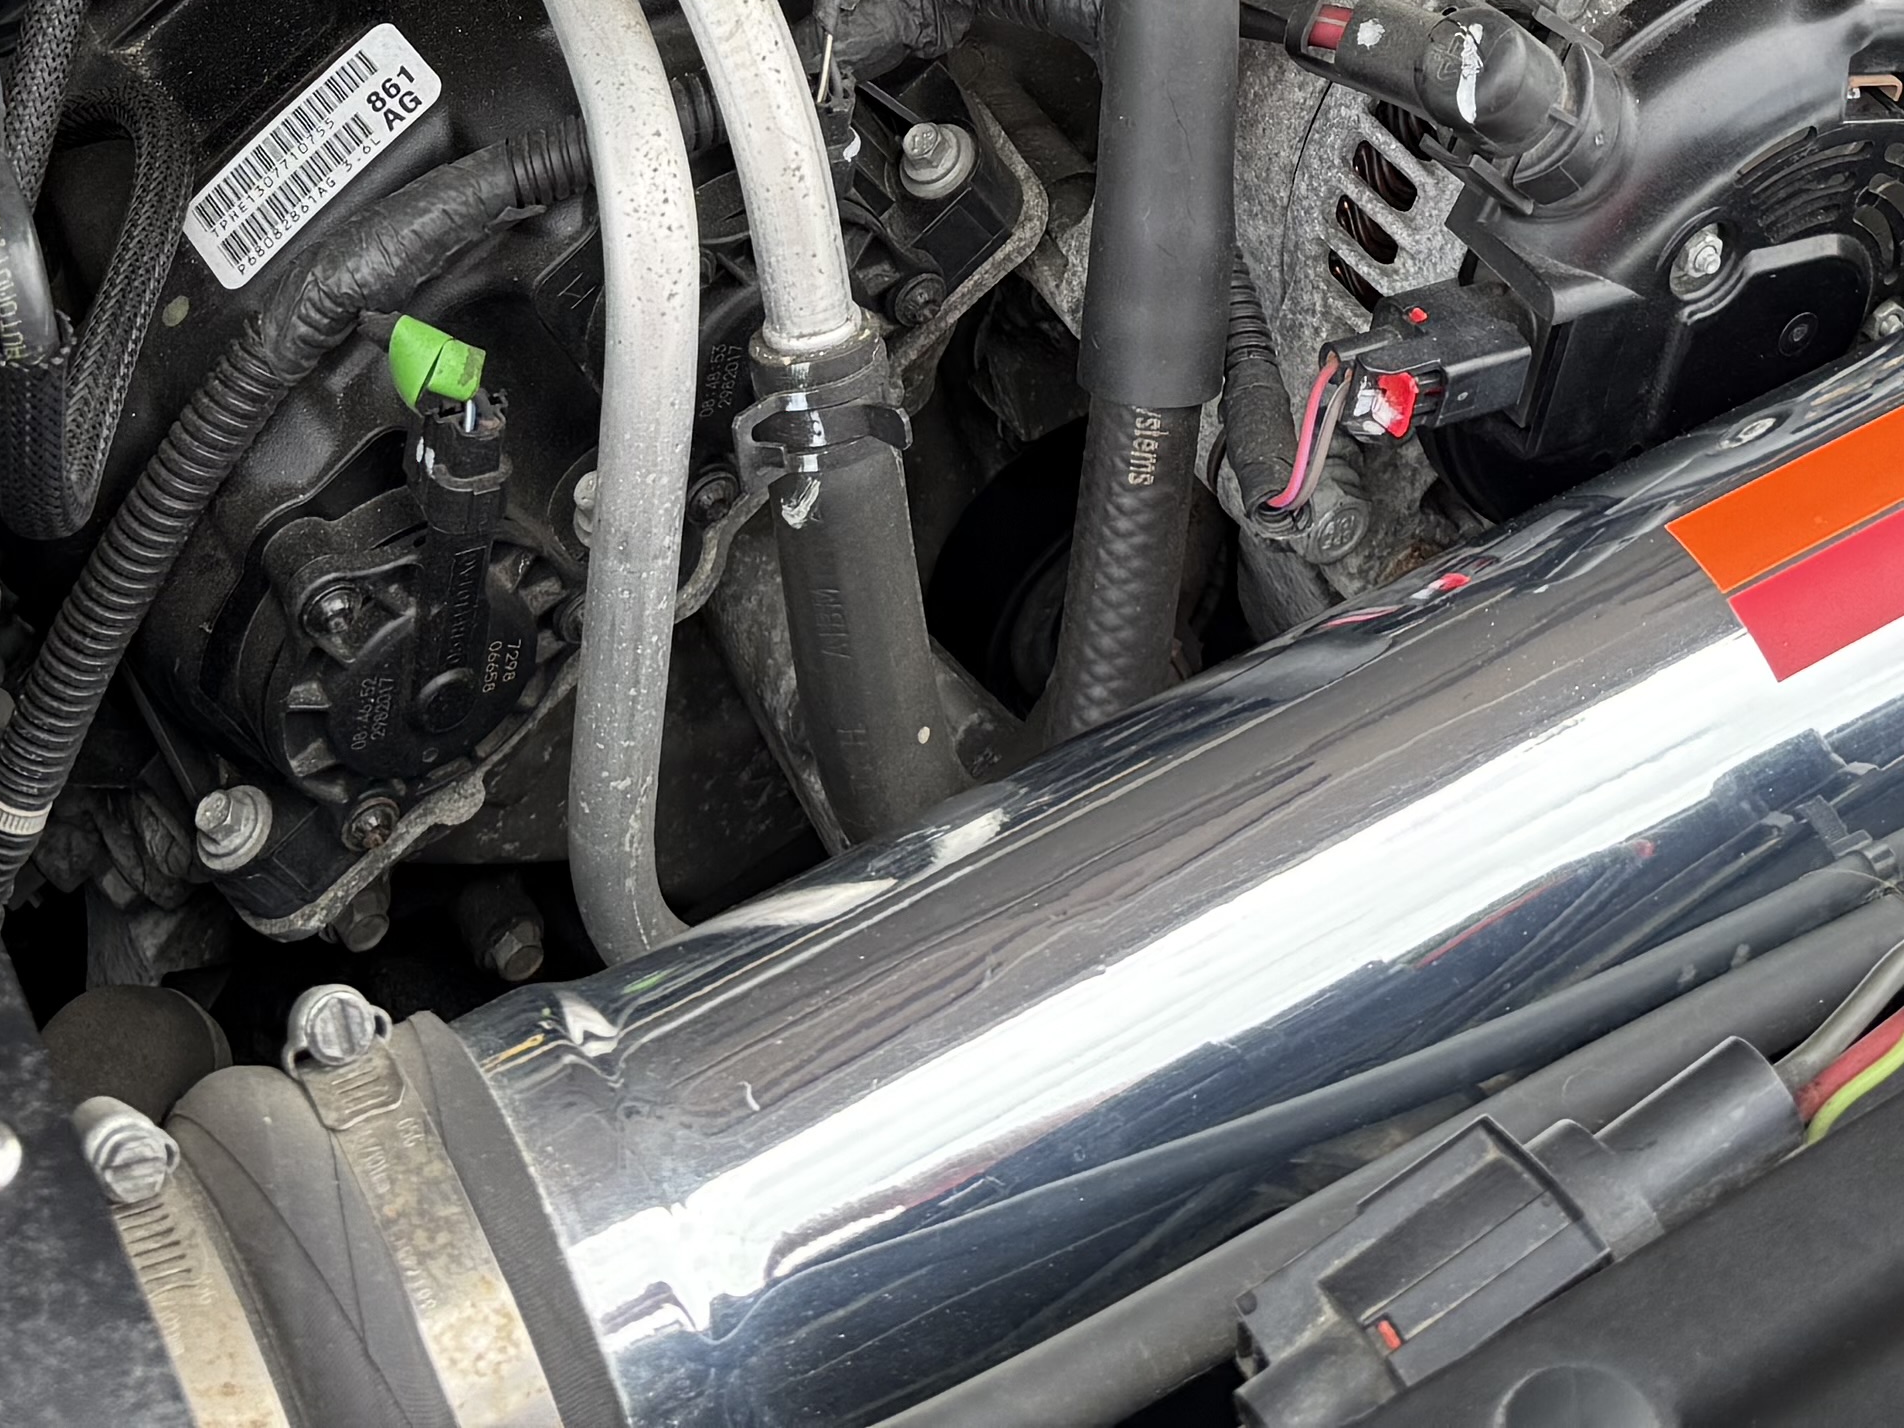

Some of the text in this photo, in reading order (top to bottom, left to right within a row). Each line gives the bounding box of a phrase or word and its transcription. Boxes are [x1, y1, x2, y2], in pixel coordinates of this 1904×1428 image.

[366, 64, 416, 113] 861
[382, 90, 423, 132] AG
[238, 177, 337, 275] P68082861AG
[482, 640, 503, 694] 06658
[502, 638, 522, 683] 7298
